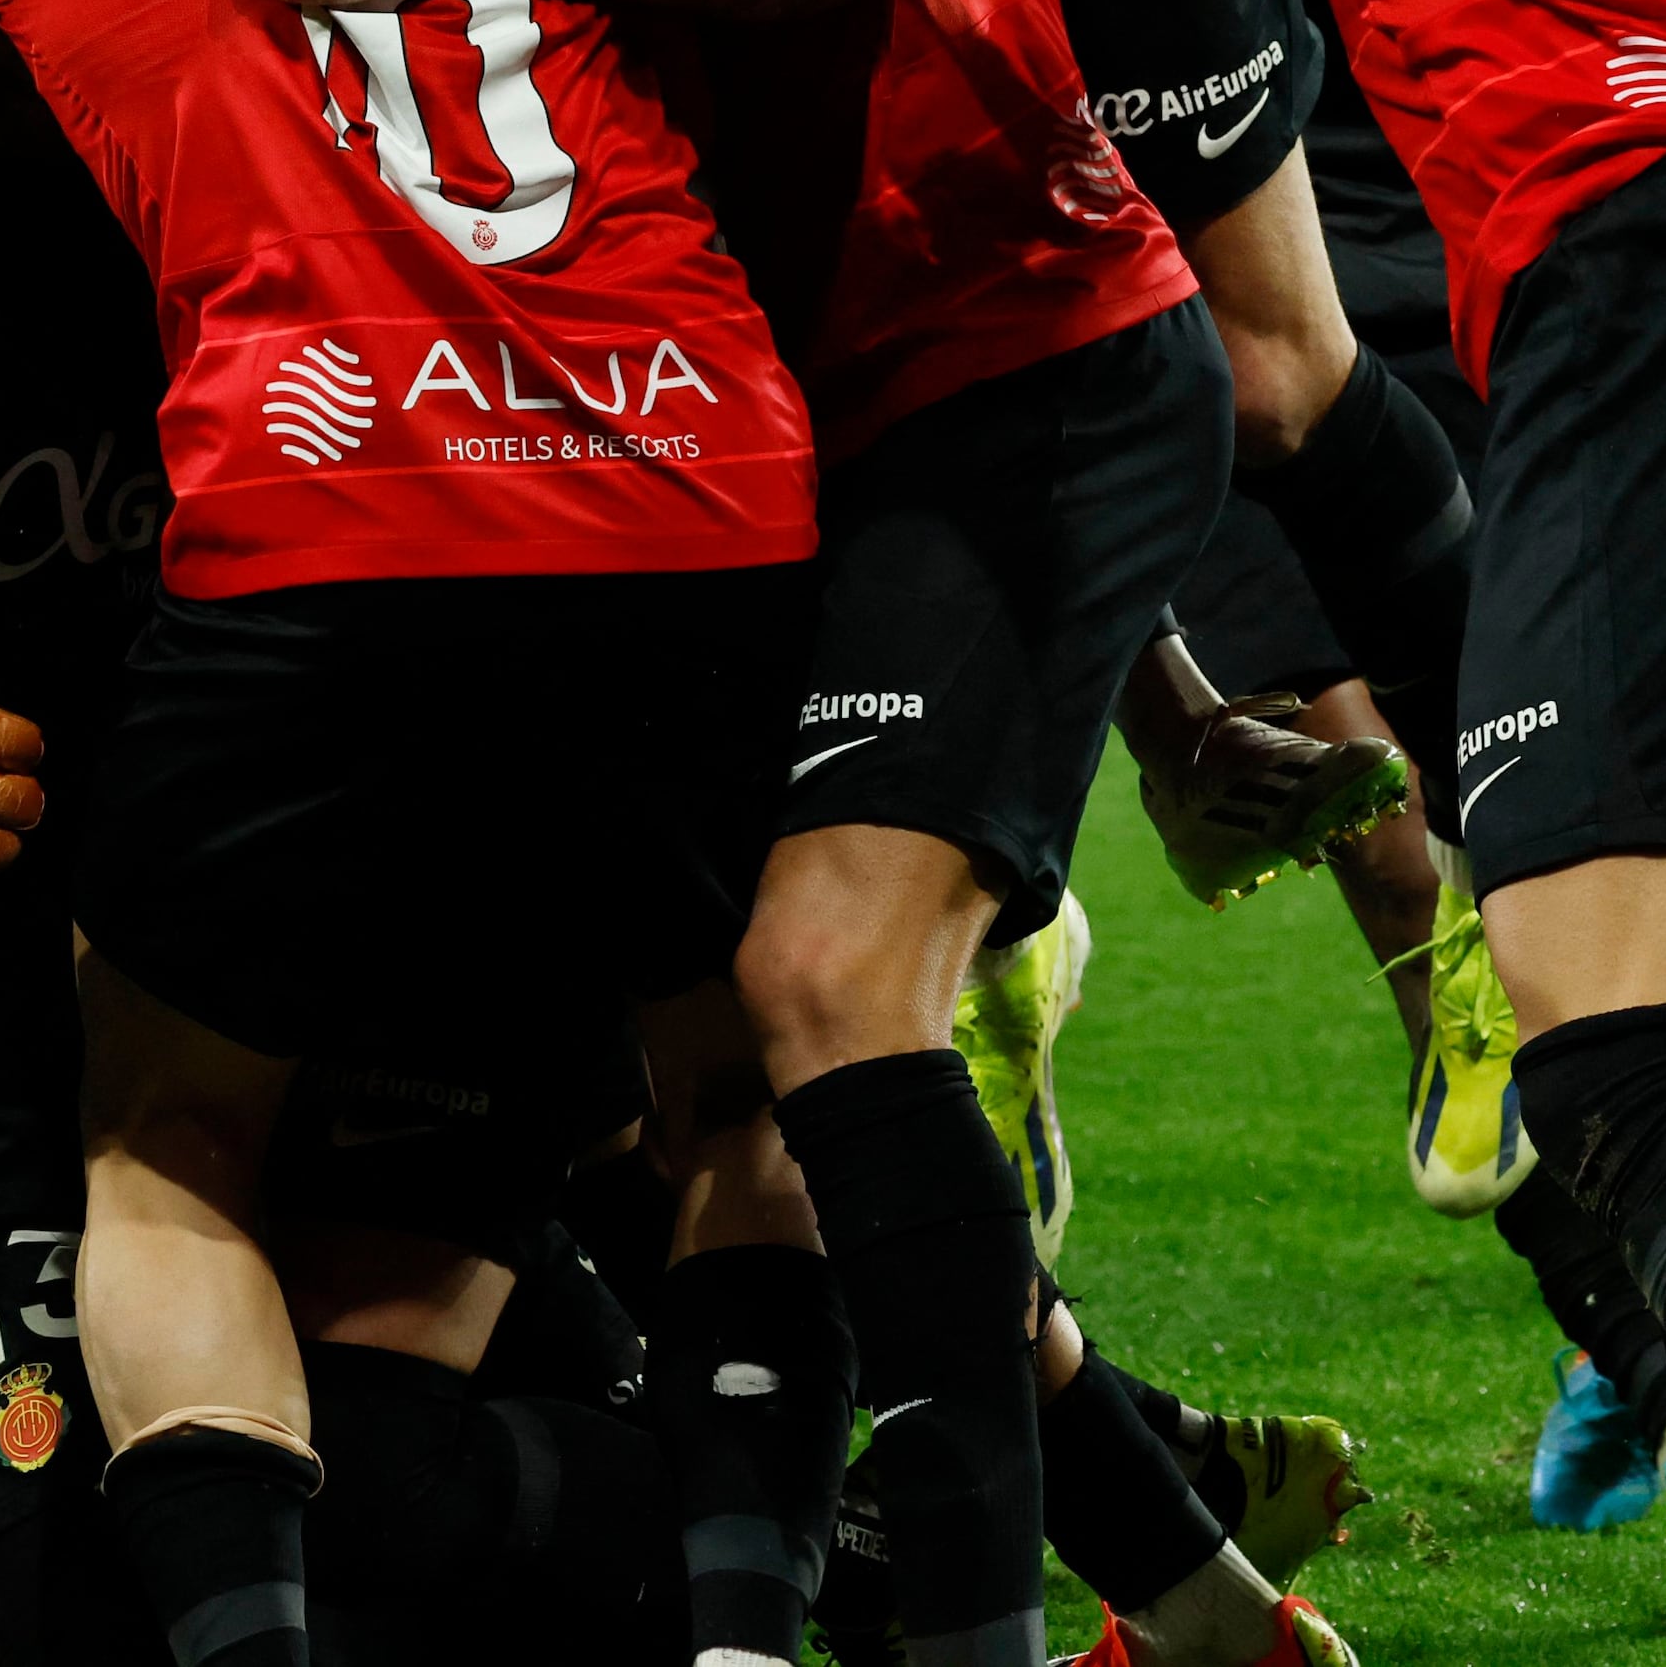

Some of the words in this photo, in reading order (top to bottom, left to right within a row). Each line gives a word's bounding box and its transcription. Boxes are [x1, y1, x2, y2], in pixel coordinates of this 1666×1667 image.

[1161, 40, 1284, 122] AirEuropa
[401, 338, 720, 417] ALUA
[445, 437, 551, 461] HOTELS
[562, 436, 582, 460] &
[588, 433, 701, 461] RESORTS
